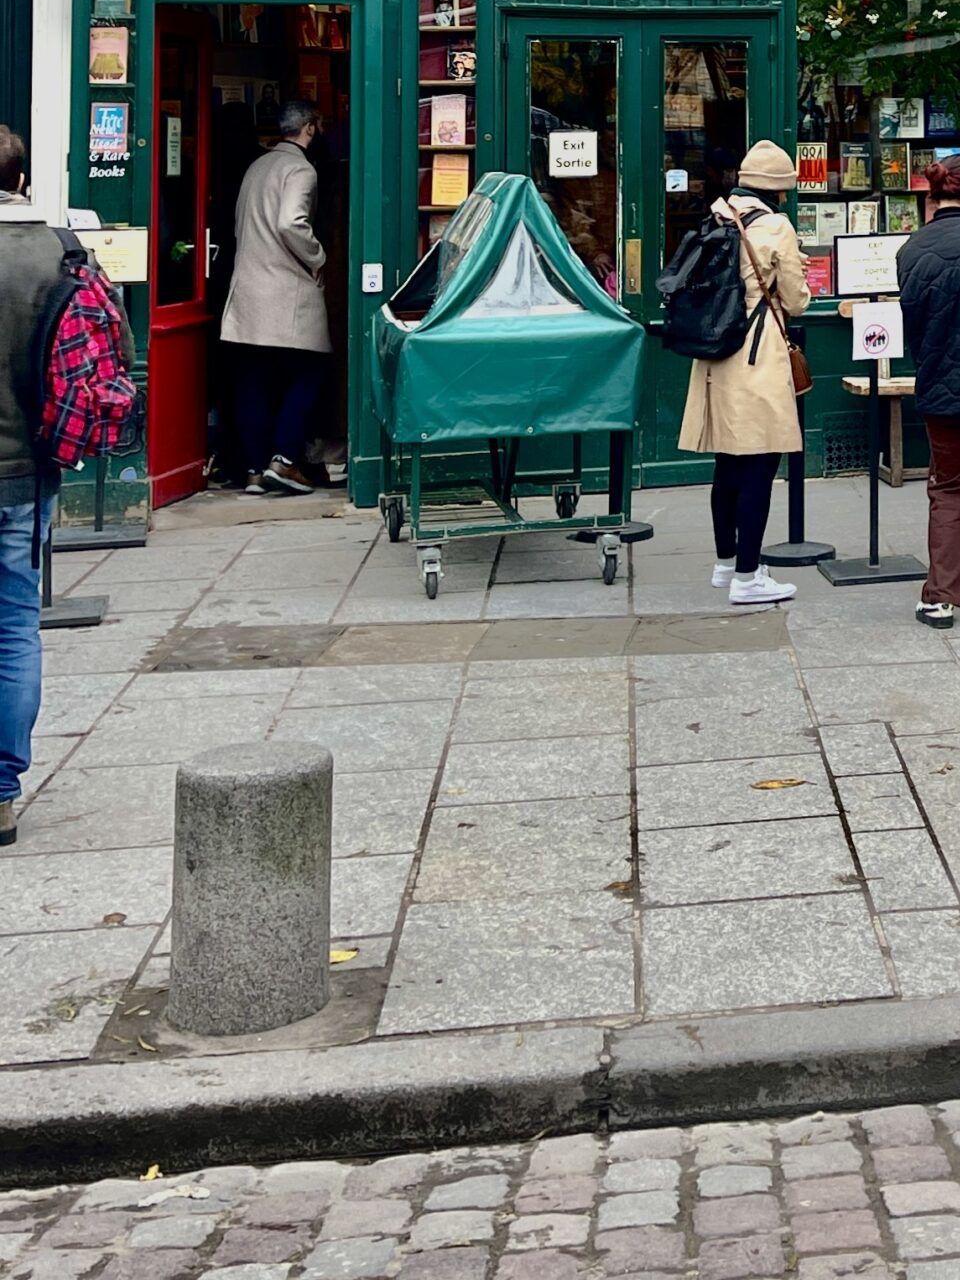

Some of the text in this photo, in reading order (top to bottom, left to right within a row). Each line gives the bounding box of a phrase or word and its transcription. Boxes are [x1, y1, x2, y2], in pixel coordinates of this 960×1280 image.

[563, 140, 584, 150] Exit
[89, 150, 131, 162] & Rare
[556, 157, 592, 168] Sortie
[89, 165, 126, 178] Books
